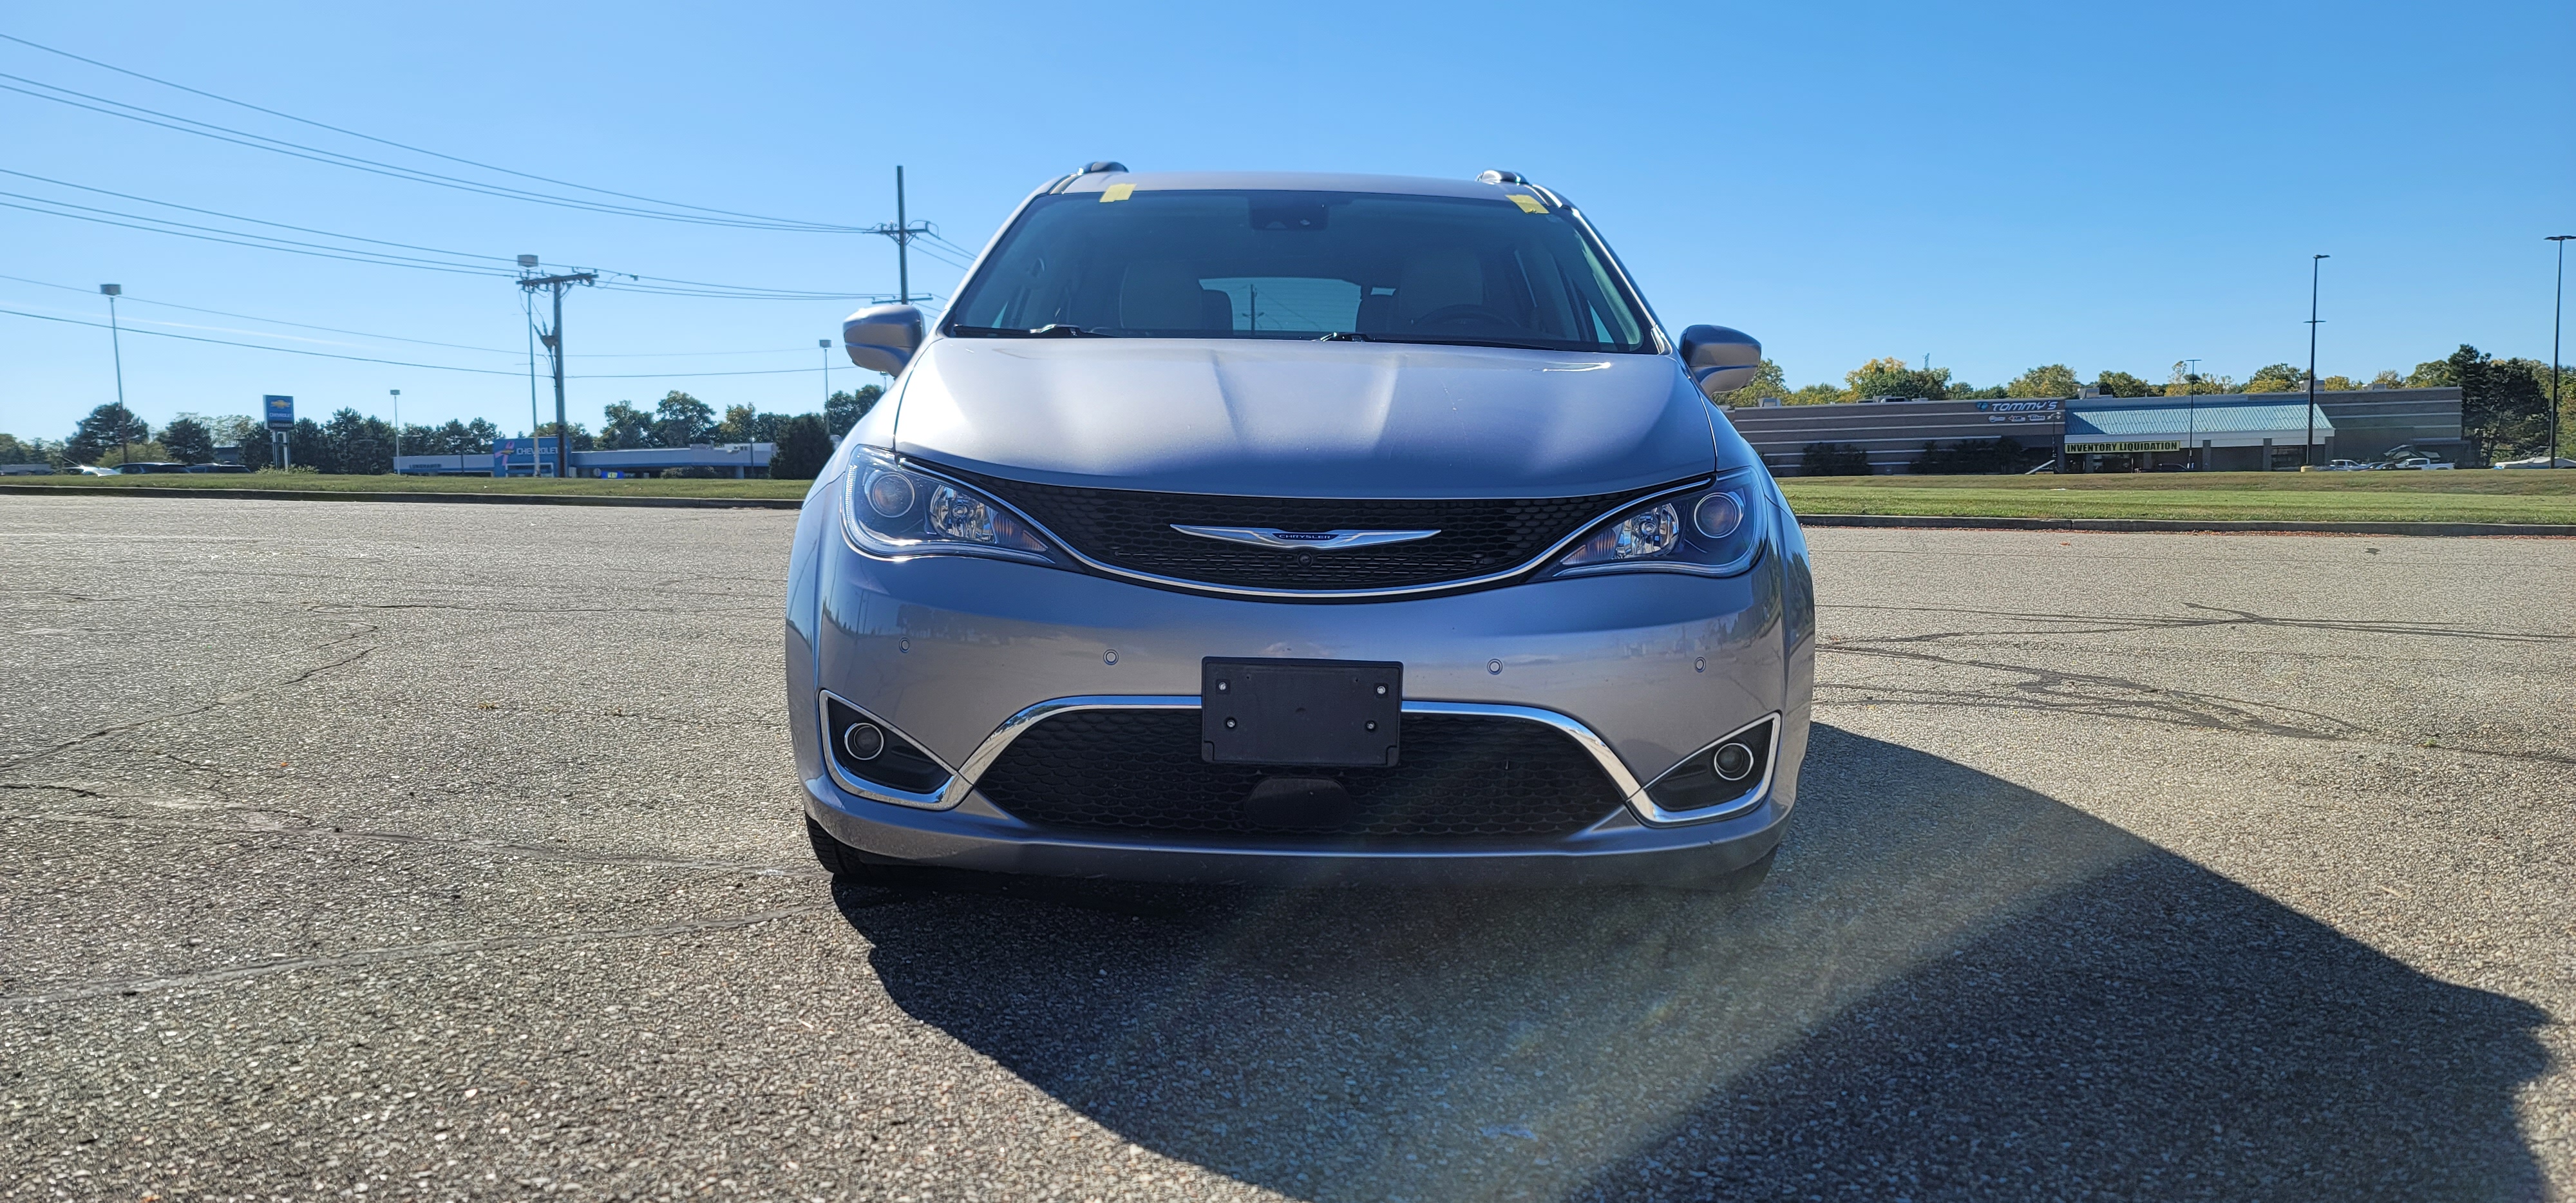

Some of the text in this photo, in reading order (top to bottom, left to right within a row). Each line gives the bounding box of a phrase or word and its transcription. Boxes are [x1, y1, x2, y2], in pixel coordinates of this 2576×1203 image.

[1991, 401, 2058, 412] TOMMY'S
[2067, 441, 2177, 452] INVENTORY LIQUIDATION
